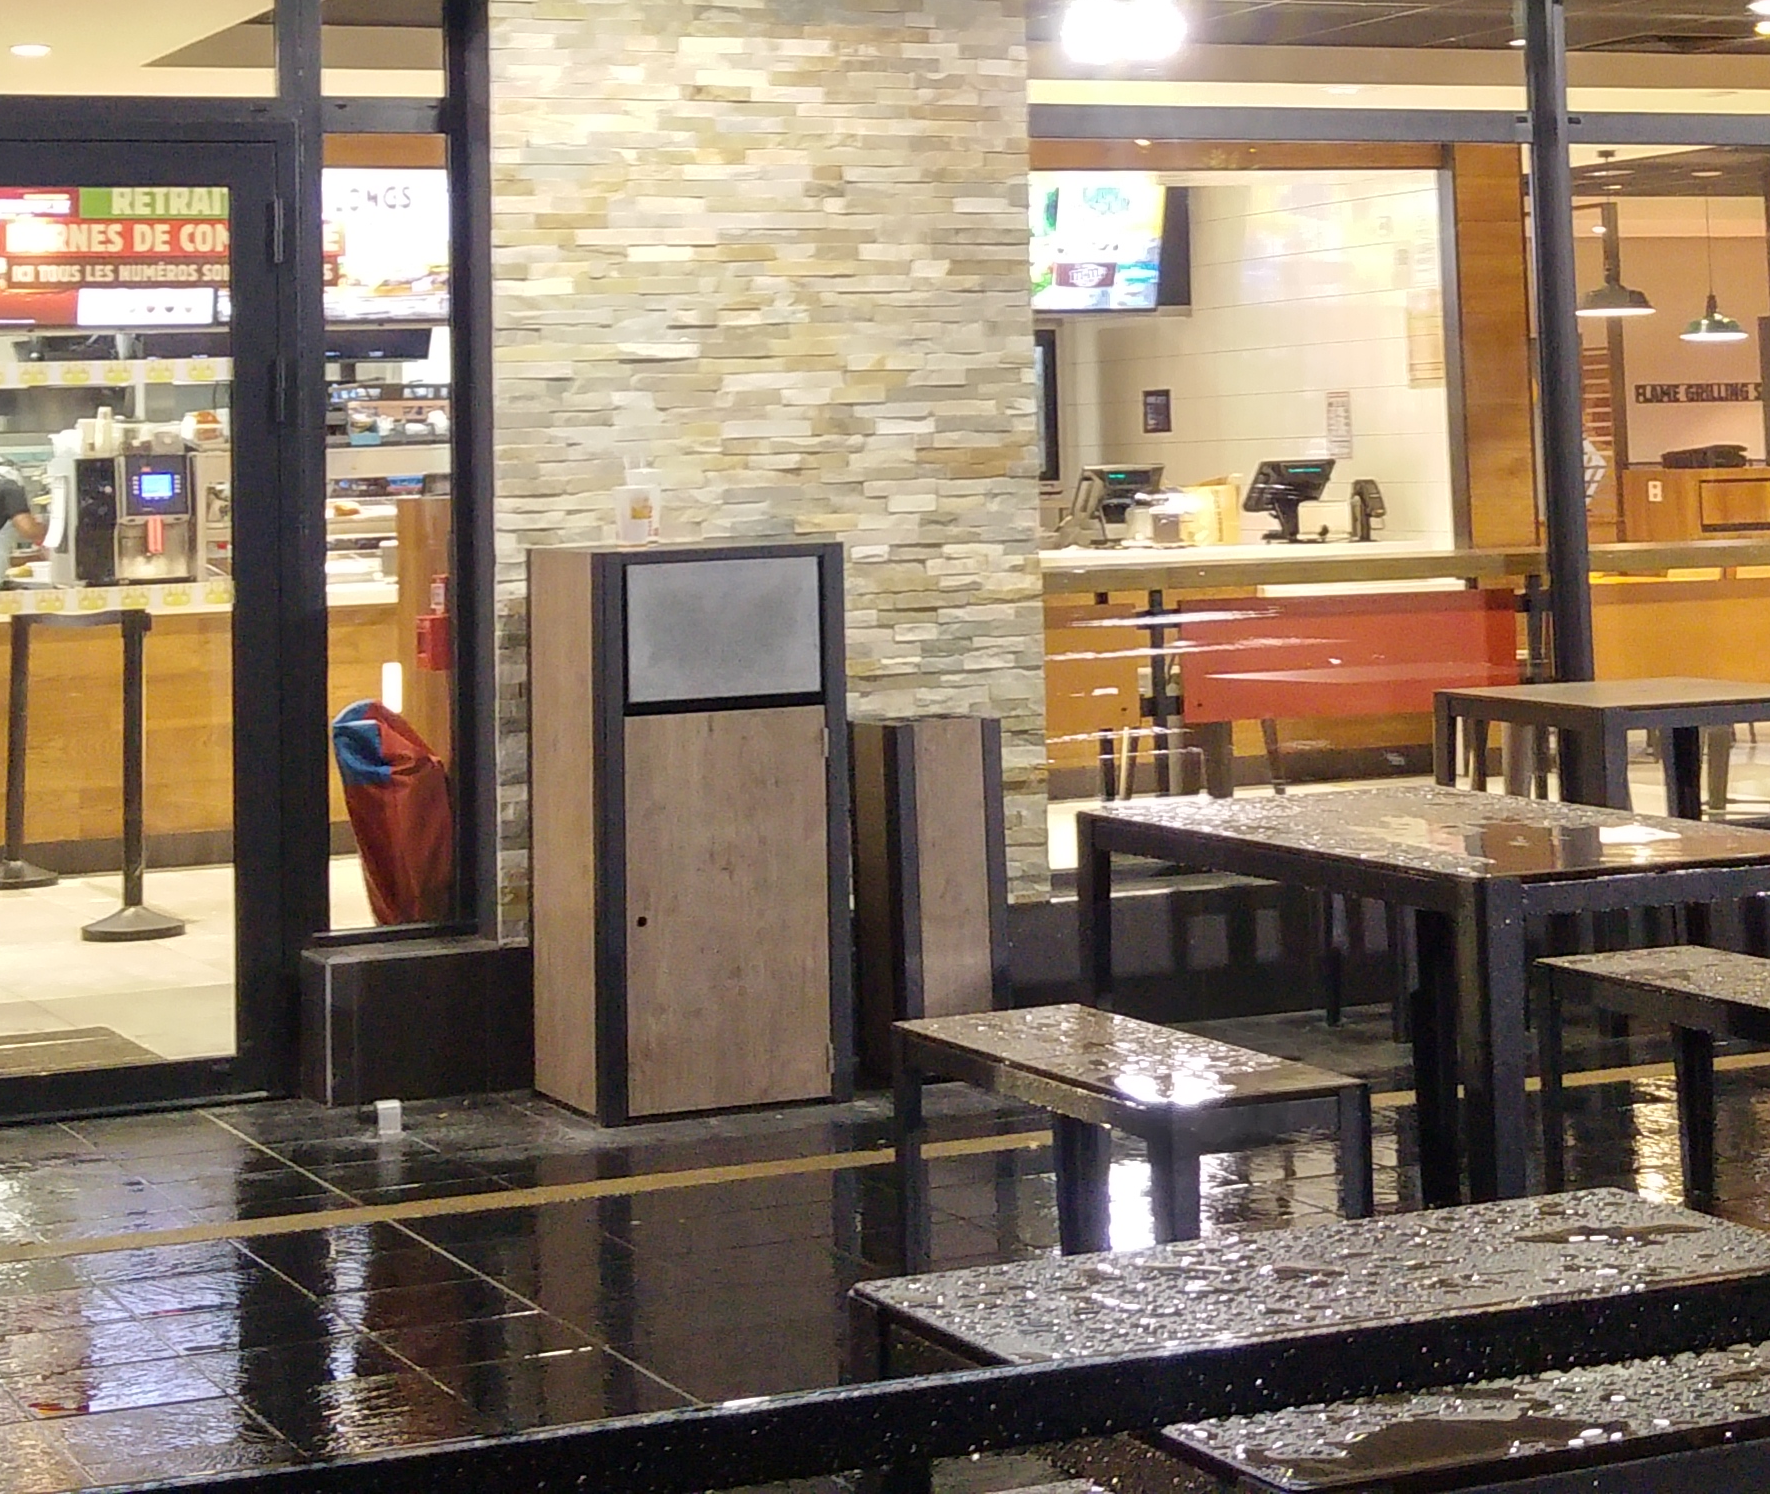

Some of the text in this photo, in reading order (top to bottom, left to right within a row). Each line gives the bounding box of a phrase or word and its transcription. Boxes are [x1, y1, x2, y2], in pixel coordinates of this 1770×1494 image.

[6, 222, 125, 253] RNES
[133, 223, 171, 253] DE
[37, 264, 81, 283] TOUS
[85, 264, 115, 282] LES
[119, 260, 199, 283] NUMÉROS
[1634, 384, 1681, 404] FLAME
[1686, 383, 1749, 403] GRILLING
